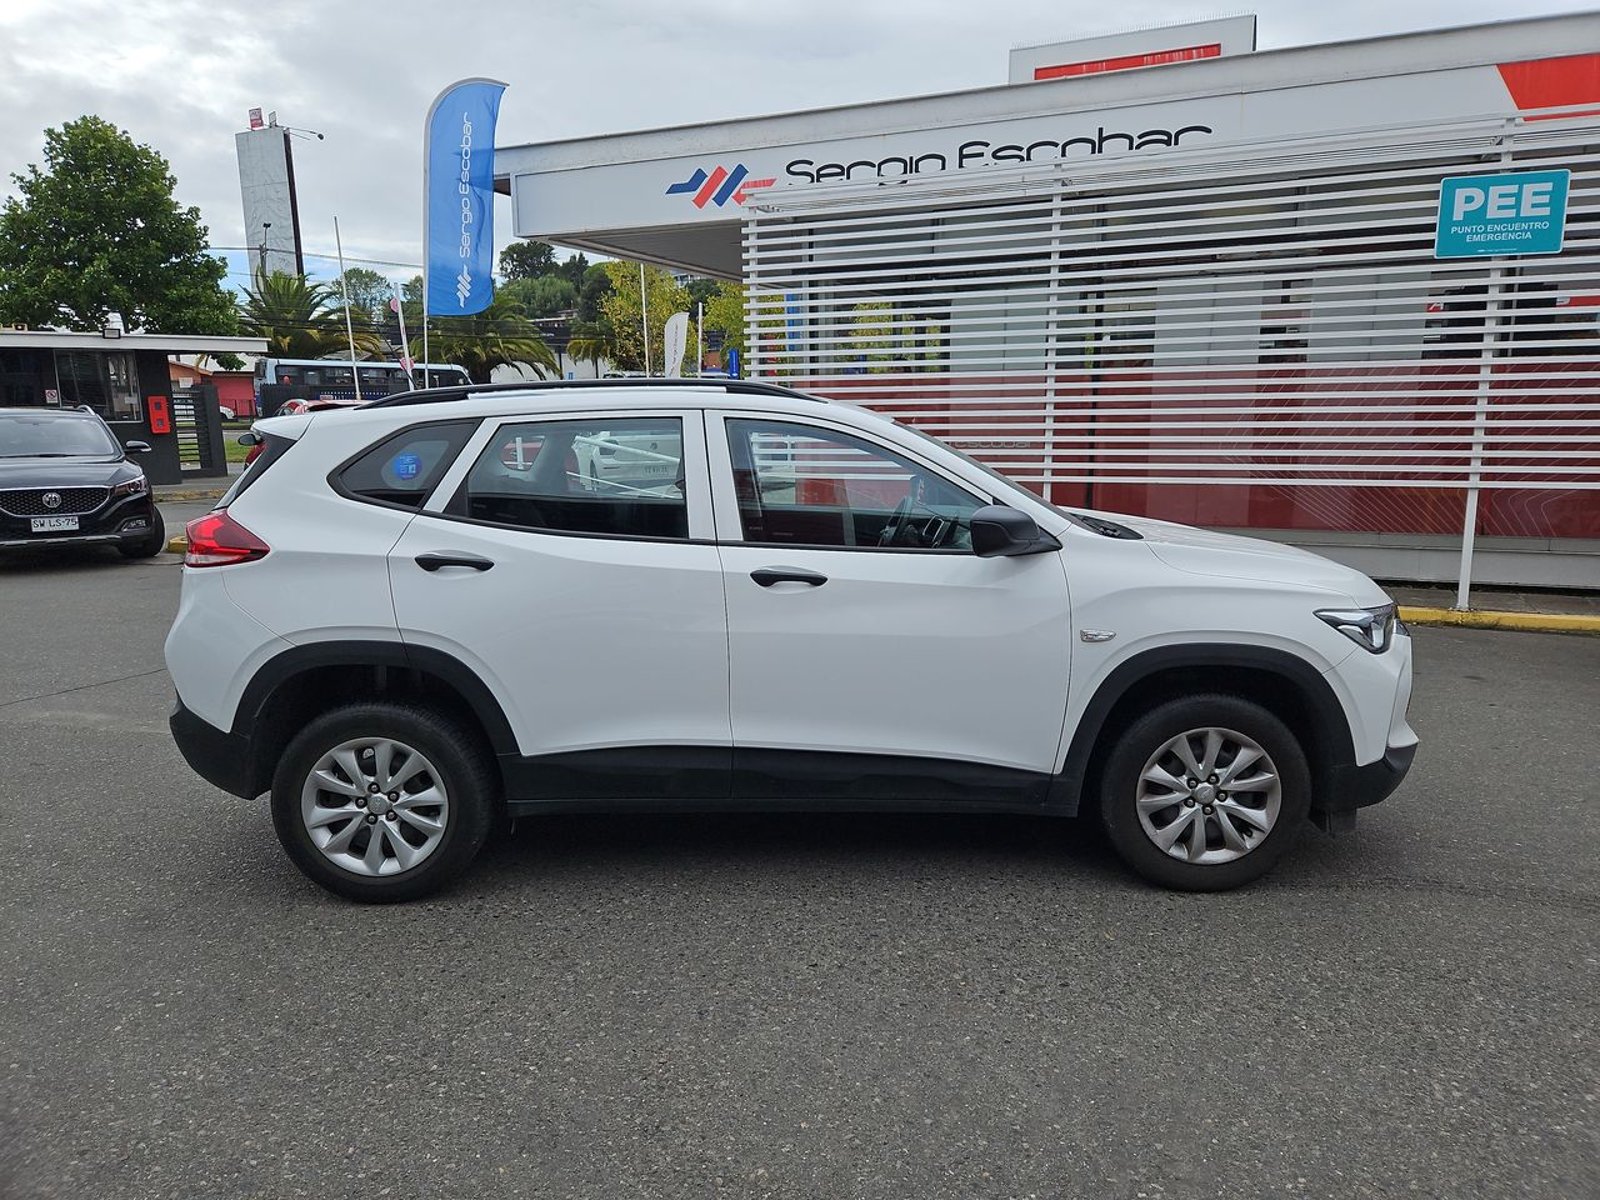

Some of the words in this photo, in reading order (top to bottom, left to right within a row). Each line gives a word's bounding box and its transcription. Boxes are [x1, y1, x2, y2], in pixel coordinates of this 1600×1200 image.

[459, 111, 472, 195] Escobar
[1452, 182, 1553, 221] PEE
[459, 198, 473, 258] Sergio
[1451, 225, 1485, 234] PUNTO
[1486, 221, 1550, 233] ENCUENTRO
[1466, 232, 1533, 242] EMERGENCIA
